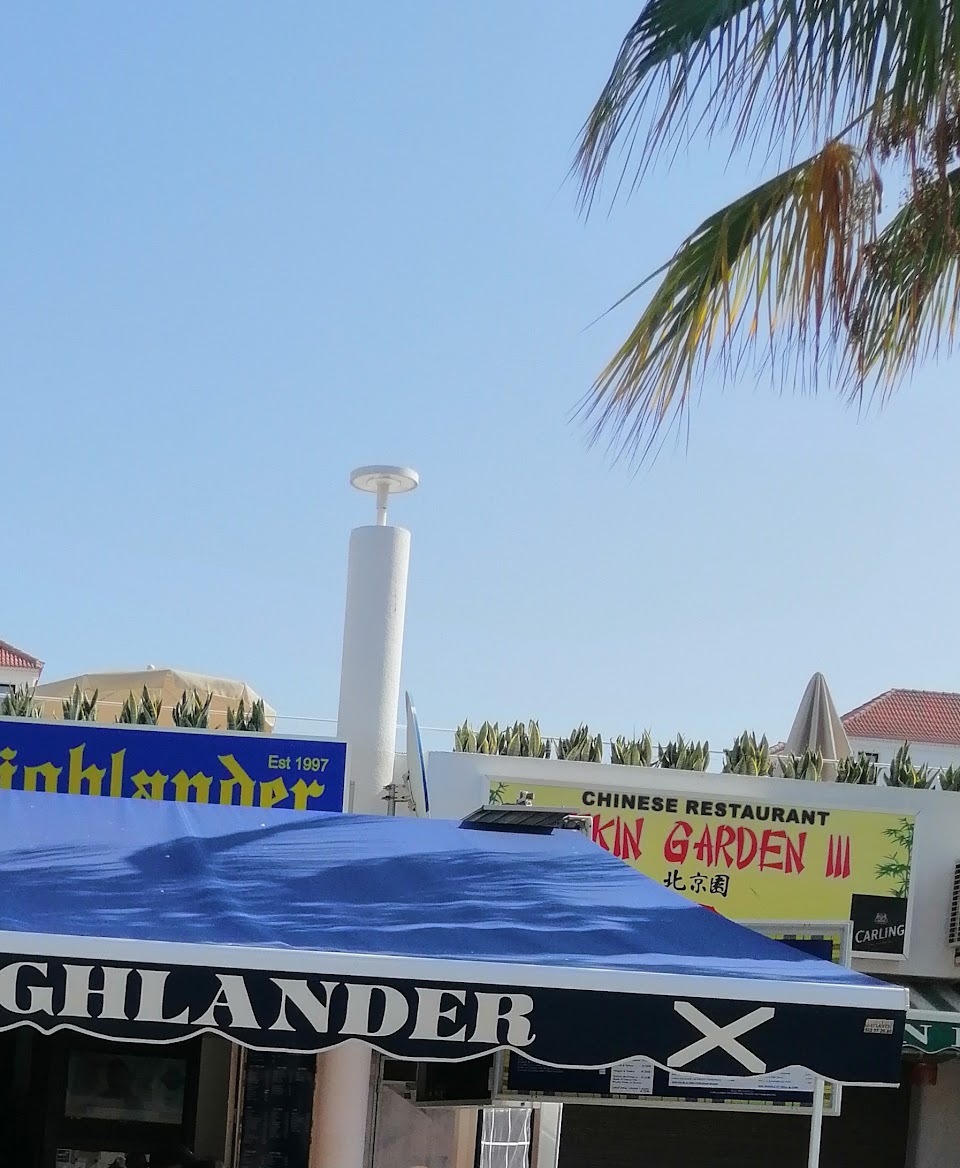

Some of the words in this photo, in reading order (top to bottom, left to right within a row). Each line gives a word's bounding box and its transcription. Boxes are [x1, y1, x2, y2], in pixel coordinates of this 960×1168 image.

[268, 754, 291, 770] Est
[295, 756, 329, 772] 1997
[581, 790, 678, 813] CHINESE
[686, 800, 830, 826] RESTAURANT
[570, 812, 644, 861] KIN
[663, 820, 807, 875] GARDEN
[825, 834, 851, 879] III
[855, 924, 905, 944] CARLING
